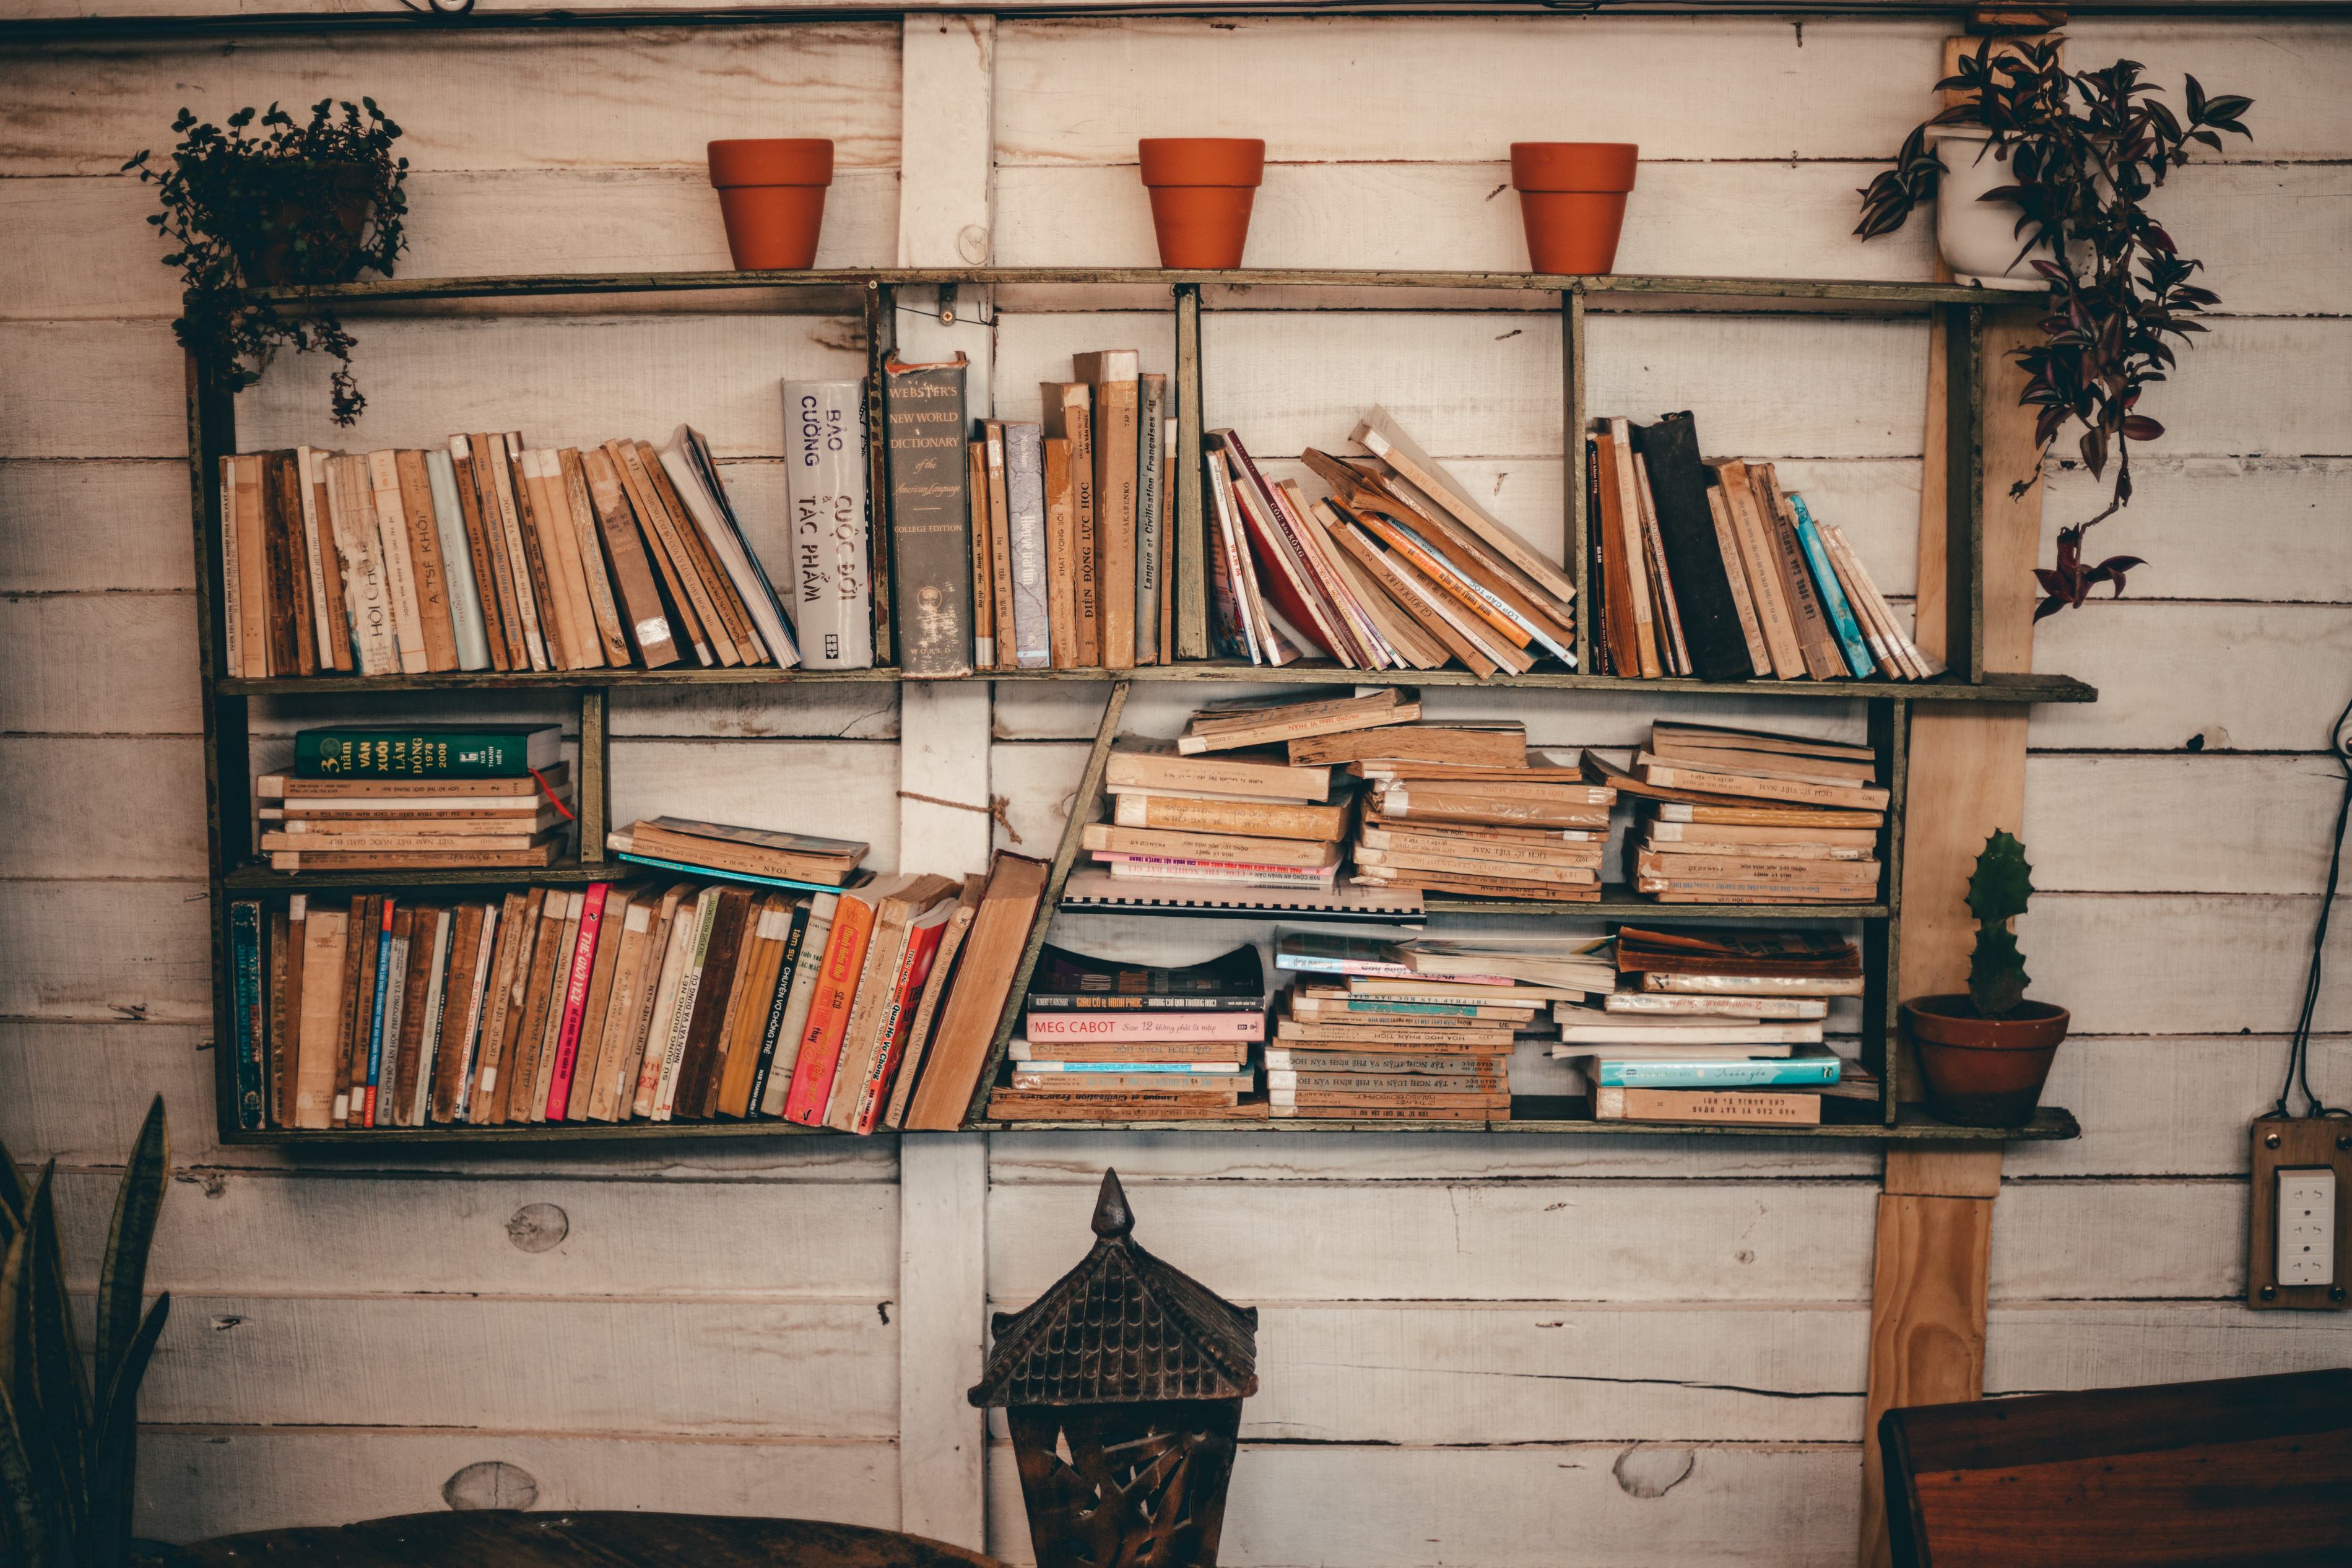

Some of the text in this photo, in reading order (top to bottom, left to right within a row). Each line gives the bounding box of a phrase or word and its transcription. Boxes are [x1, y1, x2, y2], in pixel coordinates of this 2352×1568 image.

[889, 386, 958, 398] WEBSTER'S
[890, 412, 958, 423] NEW WORLD
[801, 395, 821, 467] CƯỜNG
[826, 410, 848, 452] BẢO
[890, 438, 959, 449] DICTIONARY
[1147, 417, 1156, 472] Françaises
[913, 457, 937, 474] of the
[1020, 452, 1028, 468] Niệm
[892, 482, 961, 498] American Language
[503, 497, 511, 514] HỌC
[1145, 477, 1154, 534] Civilisation
[506, 518, 514, 534] VĂN
[894, 526, 927, 534] COLLEGE
[1269, 503, 1304, 557] CÓC hóa RỒNG
[799, 495, 830, 602] TÁC PHẨM
[830, 495, 864, 600] CUỘC ĐỜI
[1020, 516, 1036, 584] Hiểu về trái tim
[1081, 482, 1095, 618] ĐIỆN ĐỘNG LỰC HỌC
[1146, 539, 1153, 547] et
[515, 554, 524, 579] nghiên
[1144, 552, 1153, 590] Langue
[1467, 579, 1519, 622] LỚP CẤP TỐC
[911, 646, 951, 655] WORLD
[341, 742, 352, 770] năm
[358, 742, 371, 768] VĂN
[376, 741, 389, 771] XUÔI
[393, 742, 406, 769] LÂM
[407, 737, 423, 774] ĐỒNG
[425, 743, 433, 768] 1978
[438, 743, 447, 768] 2008
[1514, 850, 1525, 858] SỬ
[1145, 865, 1163, 873] ĐẮT
[1166, 865, 1199, 874] NGHIỆM
[1200, 870, 1220, 878] THỬ
[1223, 868, 1246, 877] CUỘC
[695, 903, 705, 932] MASSUMOTO
[696, 900, 716, 956] TAKASHI MASSUMOTO
[786, 929, 801, 961] tâm sự
[570, 932, 592, 1005] THẾ GIỚI YÊU
[895, 987, 903, 1003] trong
[1076, 997, 1091, 1007] GIÀU
[1092, 997, 1101, 1007] CÓ
[1101, 998, 1106, 1008] &
[1108, 998, 1125, 1007] HẠNH
[1126, 997, 1142, 1007] PHÚC
[1148, 998, 1164, 1007] KHÔNG
[1165, 998, 1173, 1007] CHỈ
[1185, 998, 1204, 1007] TRƯỜNG
[674, 974, 701, 1063] NHÂN VẬT VÀ DỤNG CỤ
[763, 967, 791, 1055] CHUYỆN VỢ CHỒNG TRẺ
[889, 1005, 900, 1026] Quan
[385, 1065, 394, 1076] SỬ
[391, 995, 400, 1029] PHƯƠNG
[662, 974, 689, 1081] SỬ DỤNG ĐƯỜNG NÉT
[885, 1027, 894, 1038] Hệ
[1035, 1021, 1064, 1033] MEG
[1069, 1021, 1116, 1033] CABOT
[1122, 1023, 1139, 1031] Size
[1142, 1021, 1153, 1031] 12
[1155, 1024, 1174, 1033] không
[1176, 1024, 1191, 1034] phải
[1202, 1024, 1216, 1033] mập
[881, 1041, 890, 1052] Vợ
[873, 1054, 887, 1080] Chồng
[1311, 1059, 1326, 1067] VĂN
[1330, 1059, 1348, 1067] BÌNH
[1383, 1060, 1404, 1068] LUẬN
[1430, 1061, 1445, 1069] TẬP
[560, 1069, 568, 1079] HẢO
[1714, 1067, 1765, 1081] Xuân yến
[753, 1081, 762, 1098] THANH
